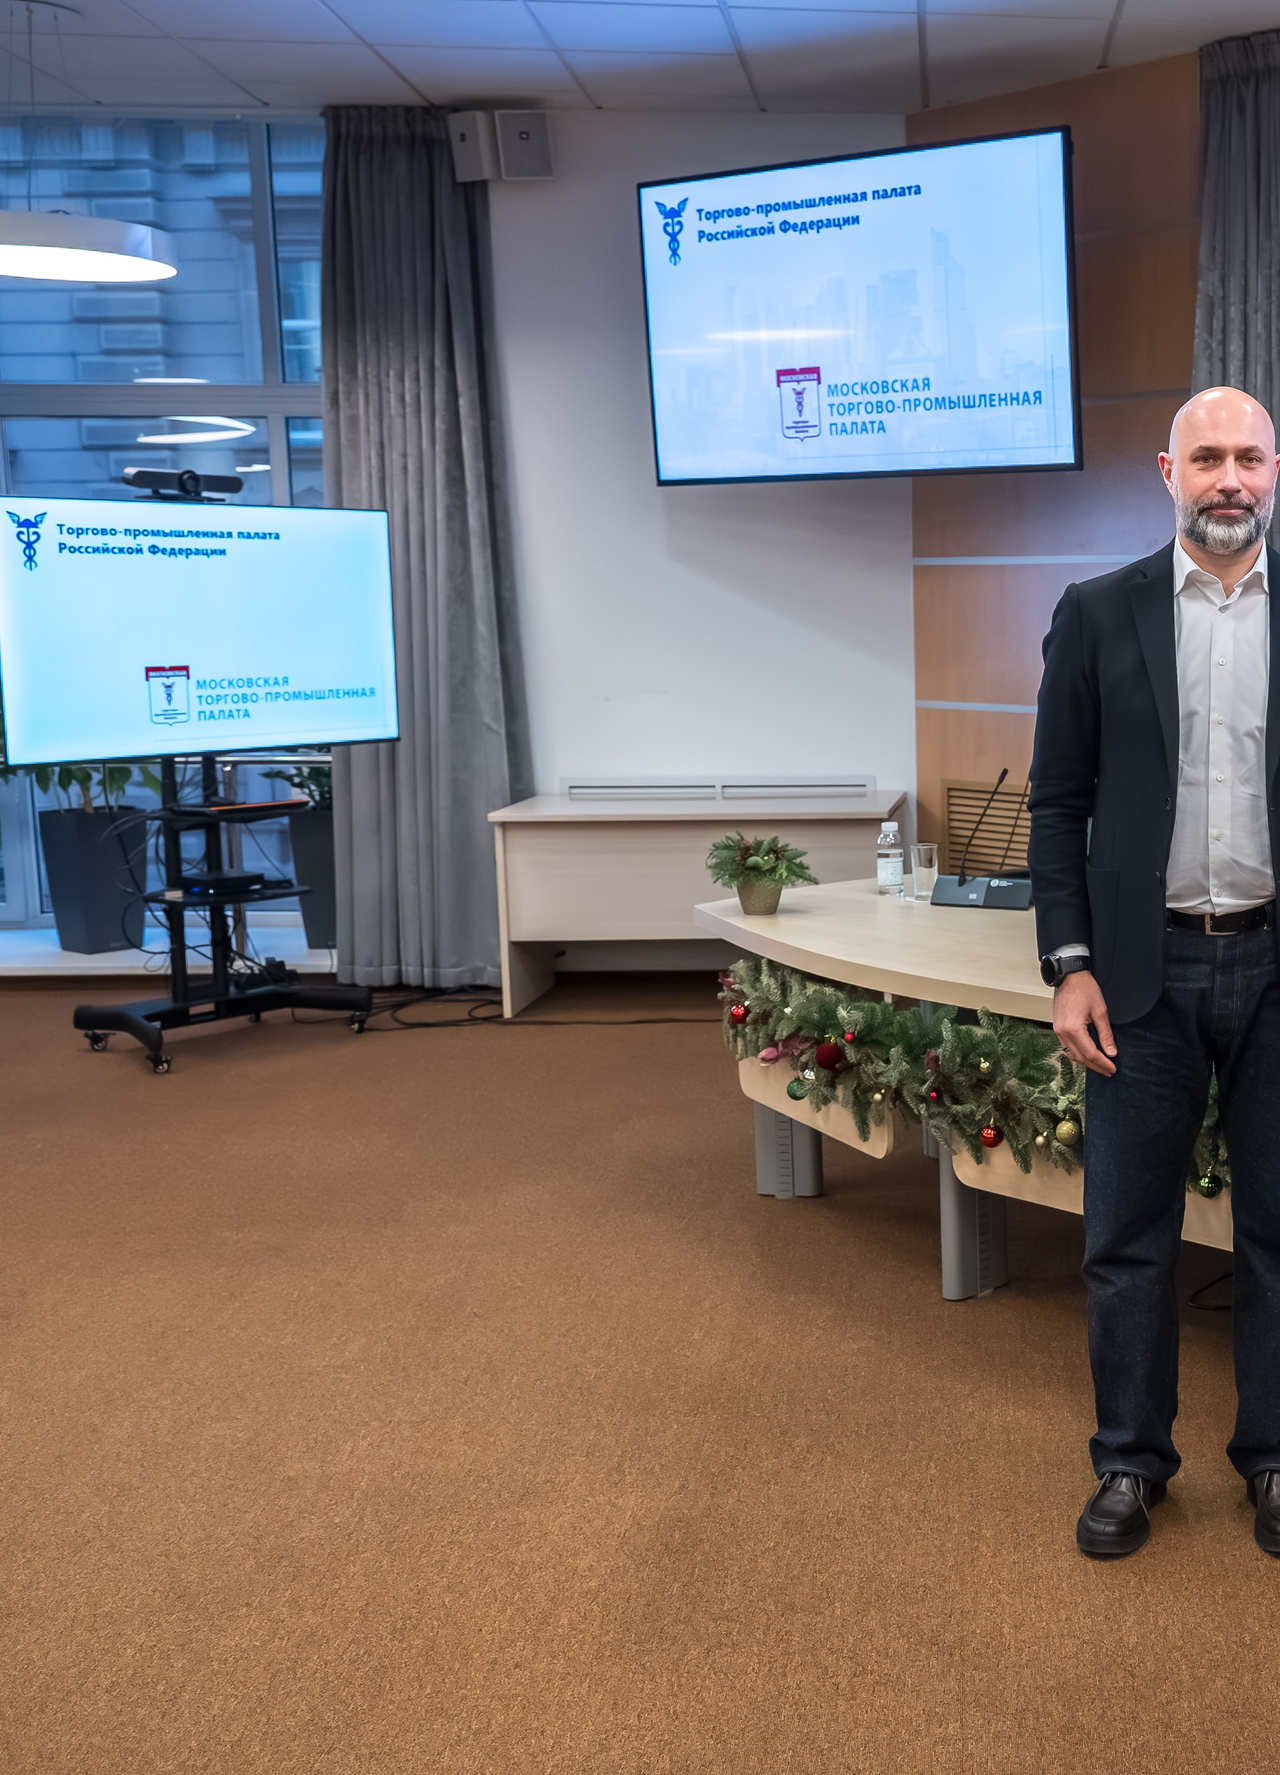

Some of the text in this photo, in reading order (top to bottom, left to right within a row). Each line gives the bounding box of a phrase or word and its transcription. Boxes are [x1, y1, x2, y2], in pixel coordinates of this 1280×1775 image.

[696, 184, 922, 223] Торгово-промышленная палата
[698, 215, 860, 243] Российской Федерации
[827, 377, 931, 397] МОСКОВСКАЯ
[828, 390, 1042, 416] ТОРГОВО-ПРОМЫШЛЕННАЯ
[829, 420, 886, 436] ПАЛАТА
[56, 523, 280, 540] Торгово-промышленная палата
[58, 542, 226, 559] Российской Федерации
[196, 676, 290, 691] МОСКОВСКАЯ
[196, 687, 376, 705] ТОРГОВО-ПРОМЫШЛЕННАЯ
[198, 708, 251, 721] ПАЛАТА
